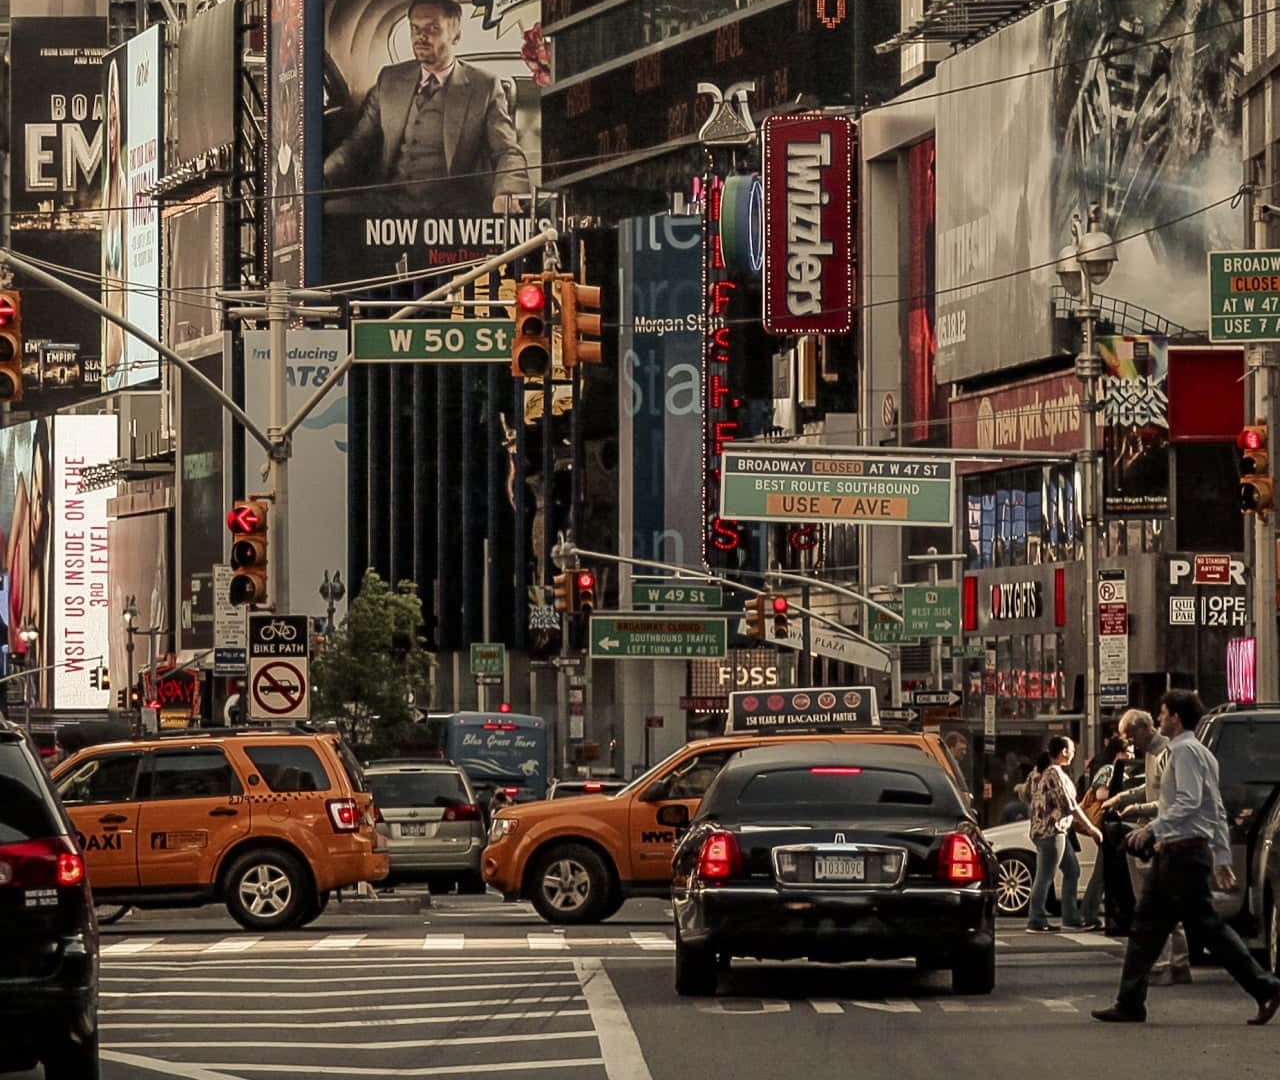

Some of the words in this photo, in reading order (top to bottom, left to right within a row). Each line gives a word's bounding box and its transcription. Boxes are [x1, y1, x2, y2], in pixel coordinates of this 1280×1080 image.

[24, 123, 104, 192] EM
[366, 218, 419, 246] NOW
[423, 219, 455, 246] ON
[786, 132, 835, 318] Twizzlers
[1223, 298, 1240, 313] AT
[1244, 298, 1257, 312] W
[1262, 297, 1278, 312] 47
[634, 315, 684, 336] Morgan
[1224, 319, 1252, 334] USE
[1259, 319, 1268, 333] 7
[389, 328, 414, 352] W
[424, 328, 465, 352] 50
[475, 328, 508, 352] St
[995, 411, 1017, 446] new
[1045, 392, 1081, 445] sports
[737, 459, 807, 474] BROADWAY
[813, 461, 863, 475] CLOSED
[869, 463, 886, 476] AT
[889, 464, 901, 476] W
[903, 463, 920, 476] 47
[923, 464, 939, 477] ST
[754, 479, 788, 492] BEST
[790, 479, 832, 493] ROUTE
[836, 480, 920, 495] SOUTHBOUND
[64, 499, 86, 521] ON
[782, 496, 820, 514] USE
[831, 497, 845, 515] 7
[851, 497, 891, 517] AVE
[64, 530, 86, 586] INSIDE
[90, 581, 110, 608] 3RD
[648, 589, 660, 601] W
[665, 589, 685, 601] 49
[690, 589, 705, 602] St
[999, 583, 1014, 620] NY
[1014, 580, 1038, 620] GIFTS
[1208, 595, 1246, 612] OPE
[64, 595, 86, 618] US
[1208, 611, 1228, 626] 24
[629, 633, 683, 643] SOUTHBOUND
[686, 633, 717, 643] TRAFFIC
[815, 636, 846, 652] PLAZA
[253, 644, 276, 654] BIKE
[279, 644, 304, 654] PATH
[627, 645, 646, 654] LEFT
[650, 645, 671, 654] TURN
[674, 645, 683, 654] AT
[710, 646, 719, 655] ST
[759, 716, 777, 725] YEARS
[778, 715, 786, 725] OF
[832, 712, 857, 722] PARTIES
[641, 831, 671, 844] NYC
